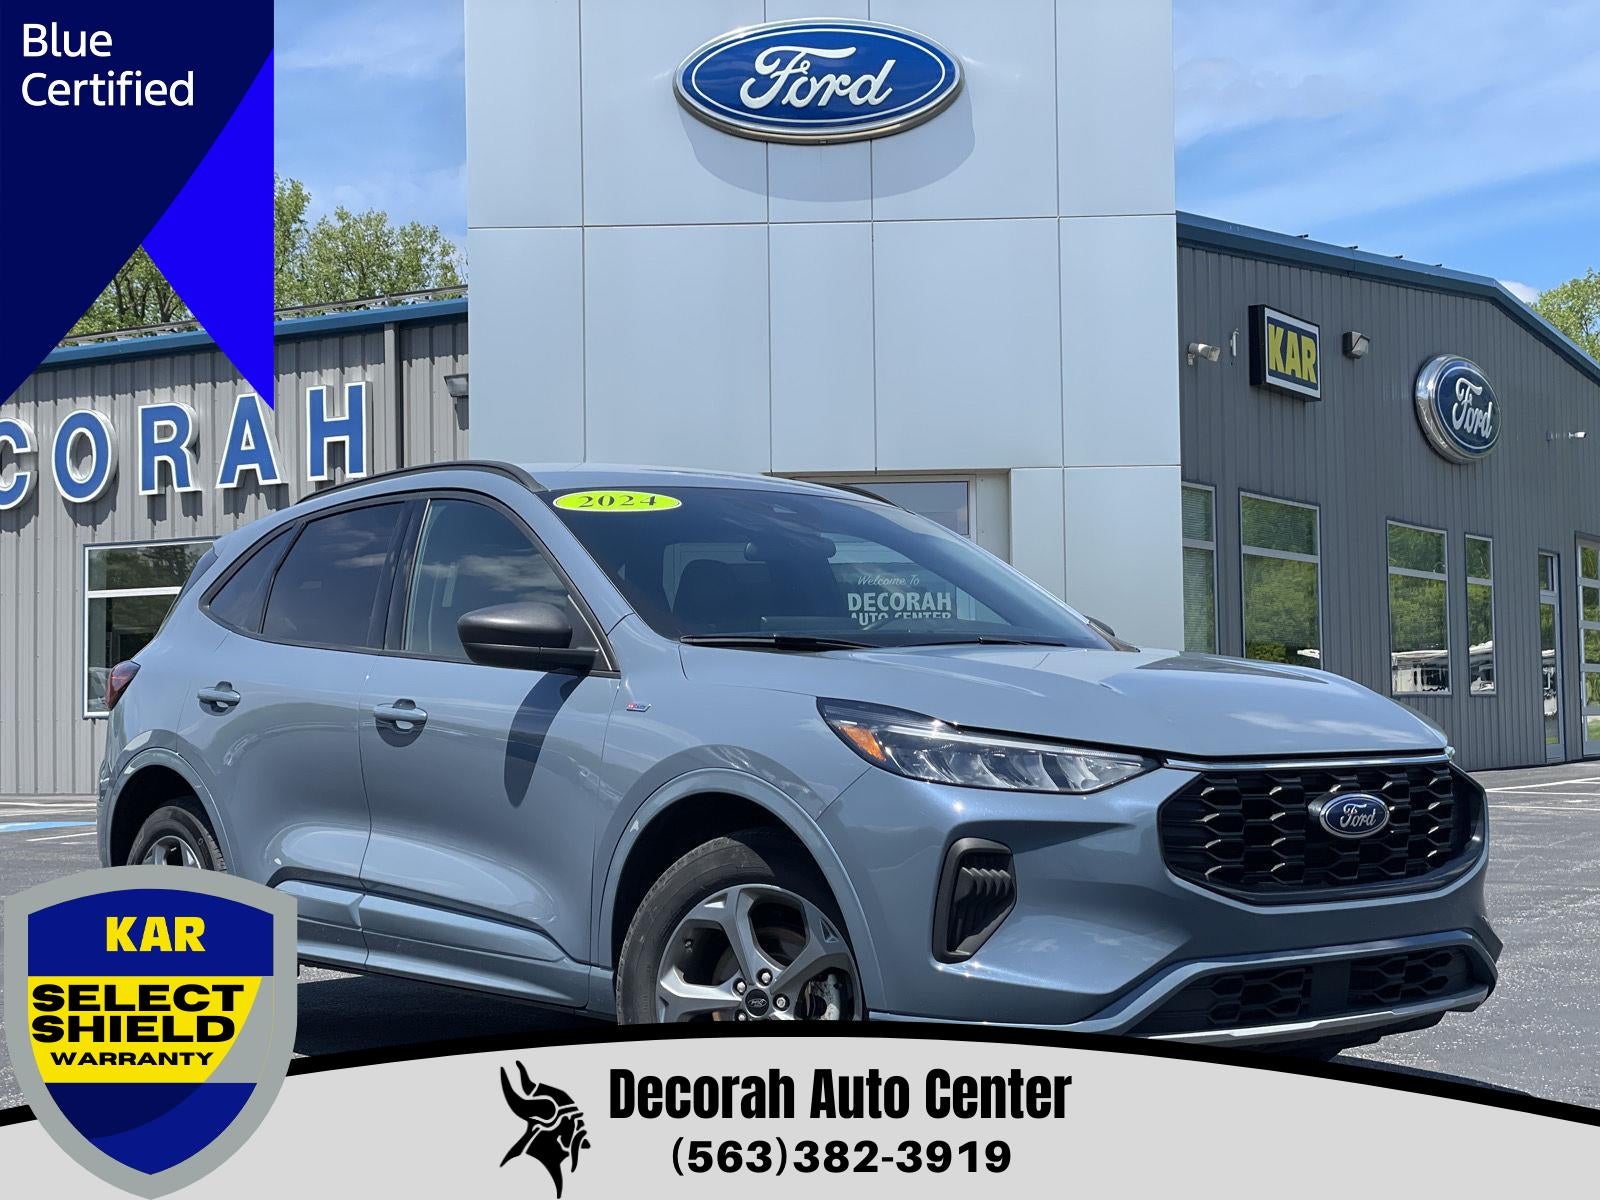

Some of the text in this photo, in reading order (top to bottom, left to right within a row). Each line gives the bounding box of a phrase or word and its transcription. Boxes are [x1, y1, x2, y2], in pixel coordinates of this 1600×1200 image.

[740, 45, 896, 109] Ford
[1268, 323, 1317, 385] KAR
[1452, 377, 1494, 439] Ford
[578, 495, 657, 508] 2024
[857, 574, 920, 586] Welcome To
[847, 592, 952, 611] DECORAH
[1340, 803, 1376, 828] Ford
